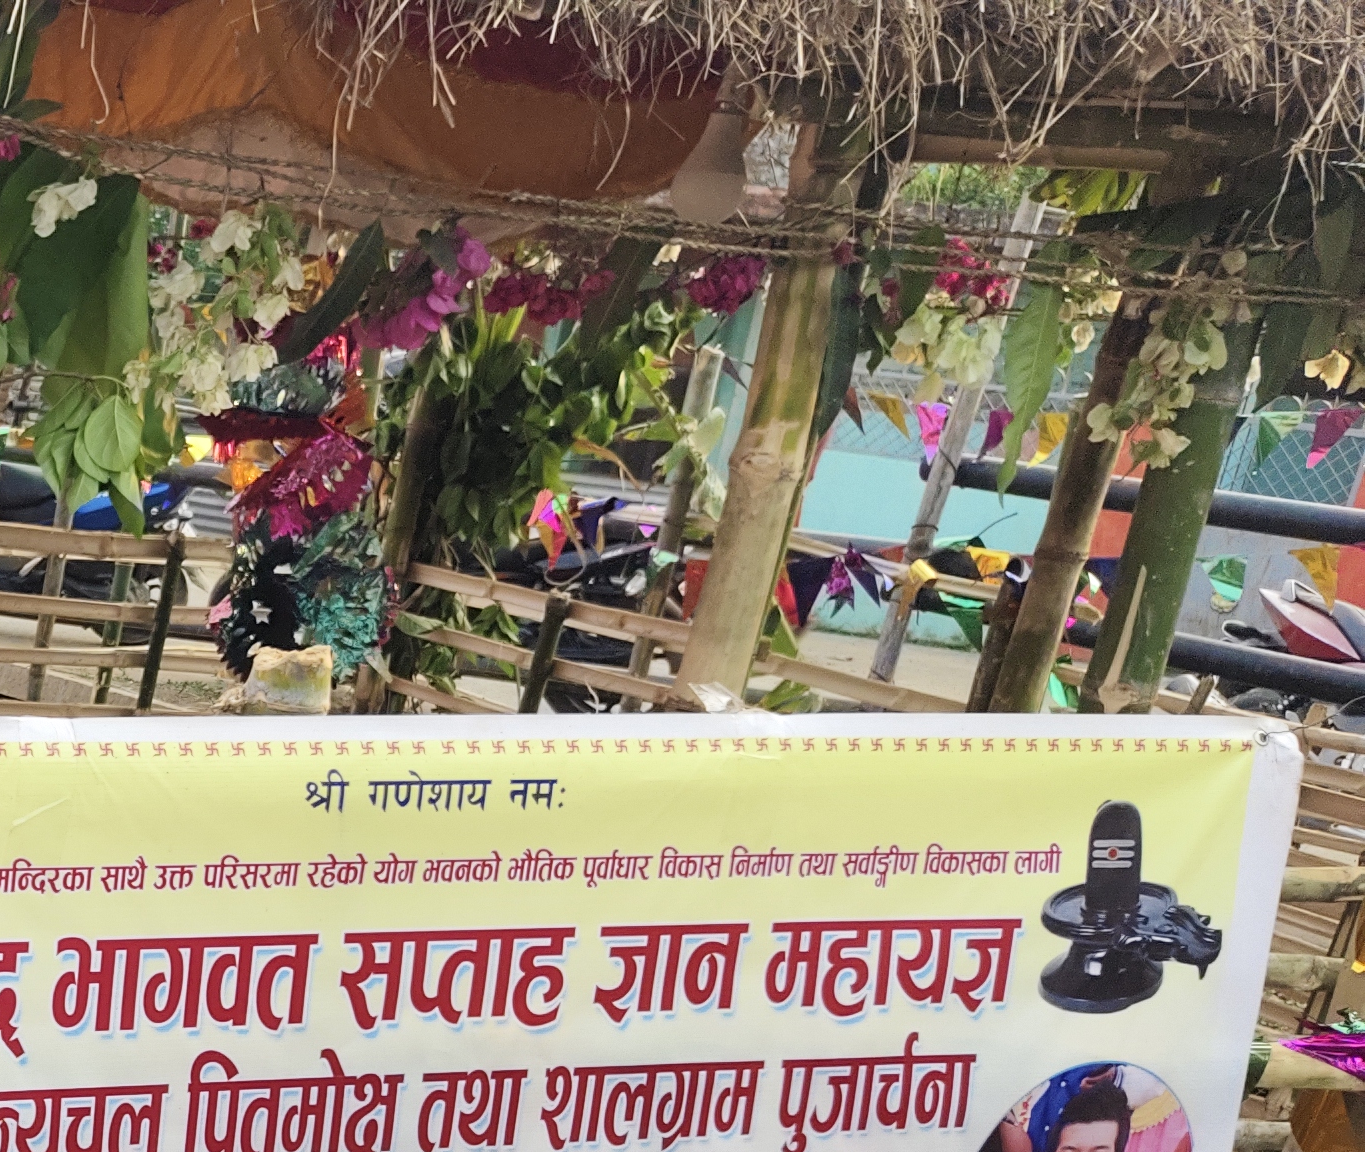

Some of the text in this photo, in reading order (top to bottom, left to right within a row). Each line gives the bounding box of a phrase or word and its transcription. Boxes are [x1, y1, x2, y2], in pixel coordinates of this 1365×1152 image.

[305, 769, 349, 813] श्री
[368, 770, 492, 812] गणेशाय
[100, 855, 148, 894] साथै
[153, 862, 194, 892] उक्त
[203, 854, 301, 890] परिसरमा
[306, 853, 367, 888] रहेको
[373, 852, 417, 884] योग
[422, 850, 501, 884] भवनको
[507, 848, 575, 882] भौतिक
[583, 848, 654, 888] पूर्वाधार
[657, 846, 724, 879] विकास
[728, 845, 794, 878] निर्माण
[798, 851, 839, 877] तथा
[922, 843, 1010, 875] विकासका
[1013, 842, 1063, 874] लागी
[51, 932, 319, 1034] भागवत
[340, 927, 576, 1030] सप्ताह
[594, 923, 749, 1024] ज्ञान
[768, 918, 1023, 1017] महायज्ञ
[540, 1060, 764, 1152] शालग्राम
